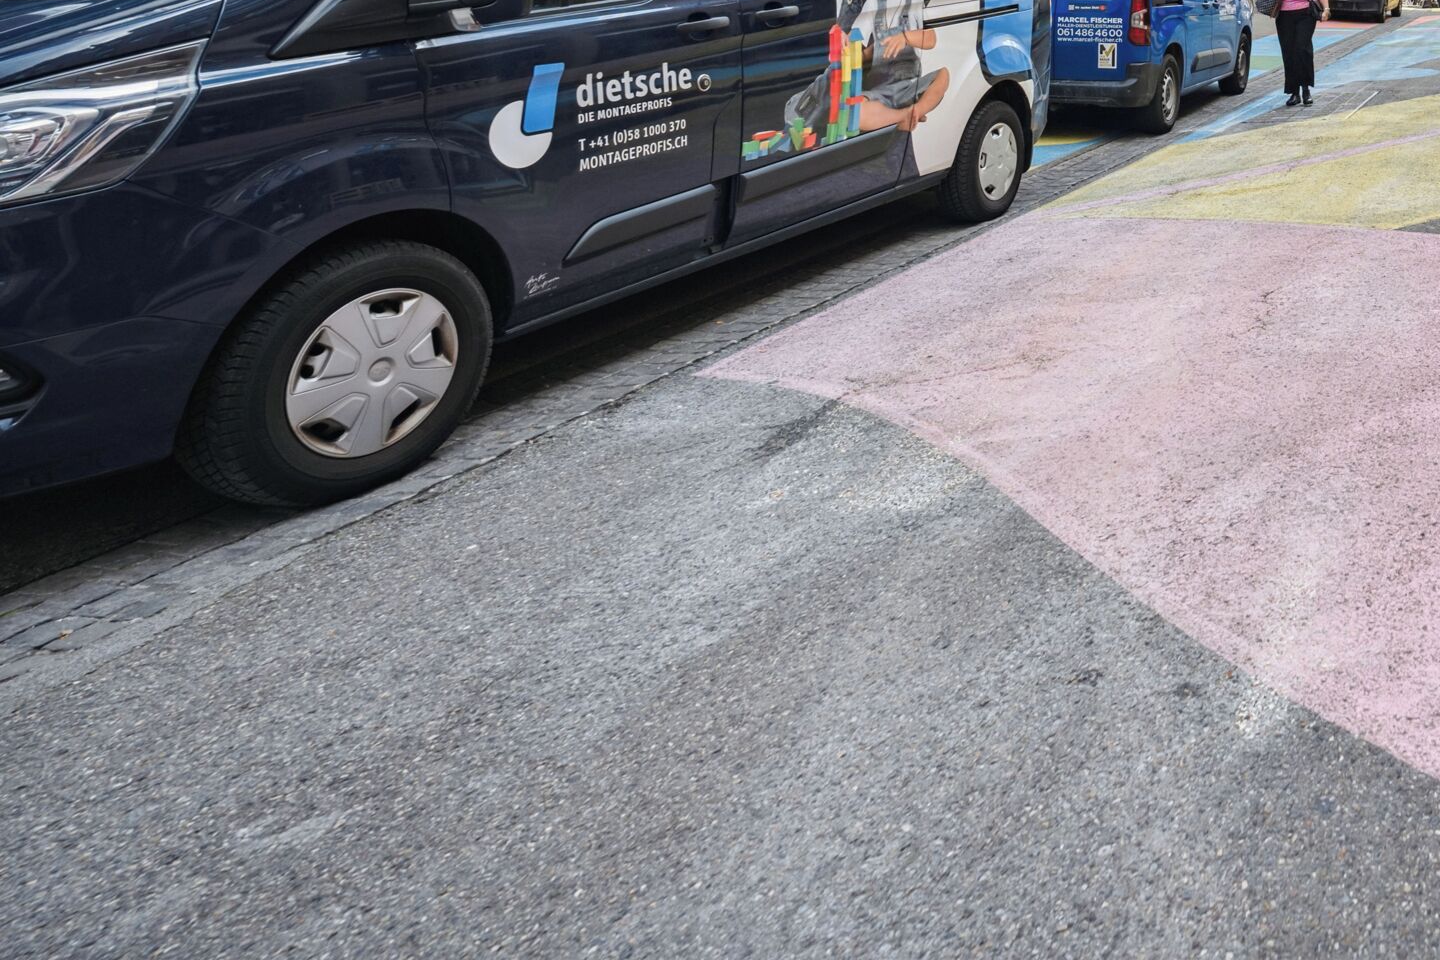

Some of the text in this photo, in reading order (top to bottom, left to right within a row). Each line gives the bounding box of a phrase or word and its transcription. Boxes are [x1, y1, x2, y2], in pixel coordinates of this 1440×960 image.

[1057, 16, 1089, 24] MARCEL
[1057, 28, 1123, 38] 061 486 46 00
[576, 62, 693, 108] dietsche
[577, 97, 673, 124] DIE MONTAGEPROFIS
[578, 119, 687, 152] T +41 (0)58 1000 370
[579, 134, 688, 172] MONTAGEPROFIS.CH
